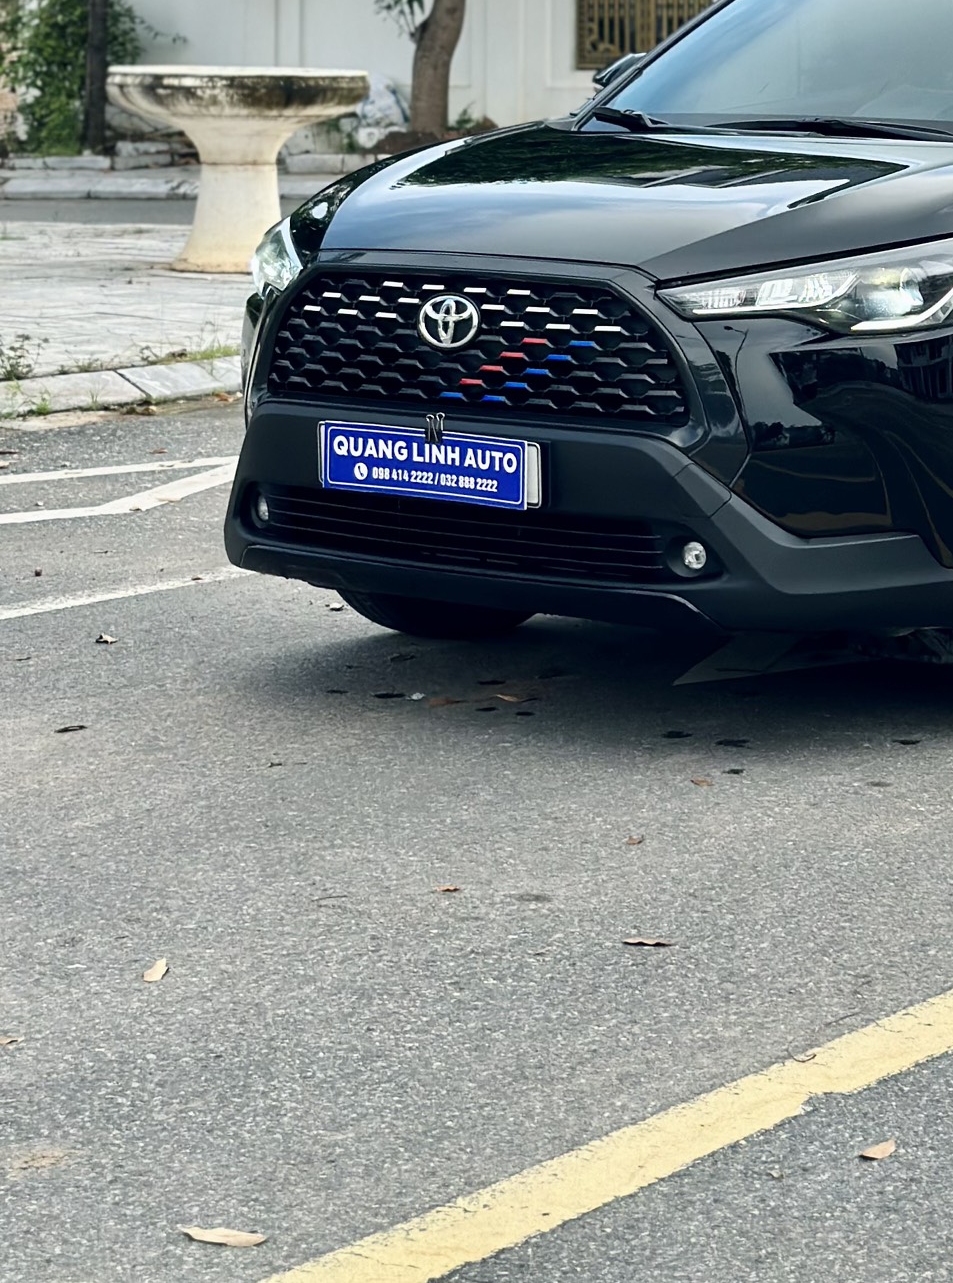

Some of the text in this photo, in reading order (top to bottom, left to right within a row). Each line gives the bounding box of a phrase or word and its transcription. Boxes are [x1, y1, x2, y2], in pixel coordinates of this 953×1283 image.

[333, 435, 518, 474] QUANG LINH AUTO
[372, 466, 390, 480] 098
[392, 468, 409, 482] 414
[410, 470, 433, 484] 2222
[440, 474, 457, 486] 032
[458, 476, 475, 489] 888
[476, 478, 498, 492] 2222
